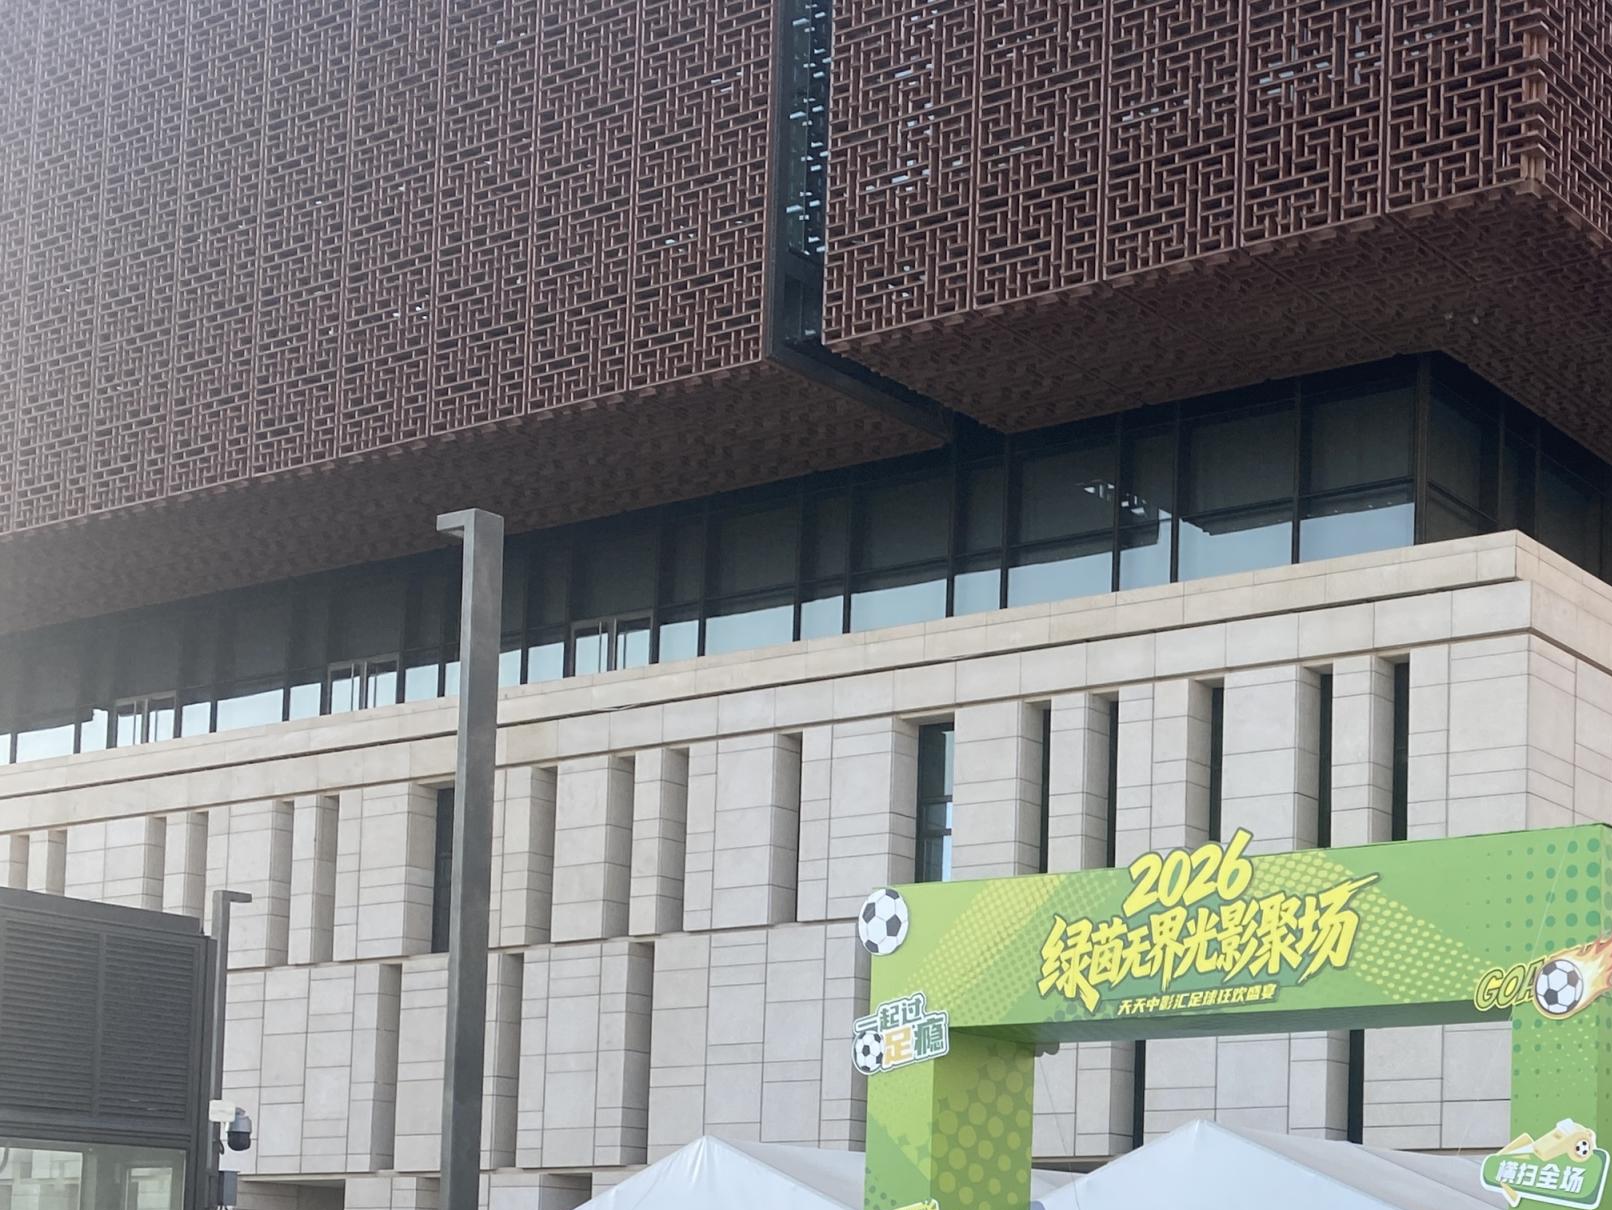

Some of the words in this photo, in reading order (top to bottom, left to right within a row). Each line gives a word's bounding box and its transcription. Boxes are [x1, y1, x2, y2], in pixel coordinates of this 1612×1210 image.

[1122, 828, 1254, 917] 2026
[1036, 872, 1380, 1014] 绿茵无界光影聚场
[857, 997, 922, 1030] 一起过
[1495, 1160, 1587, 1194] 横扫全场
